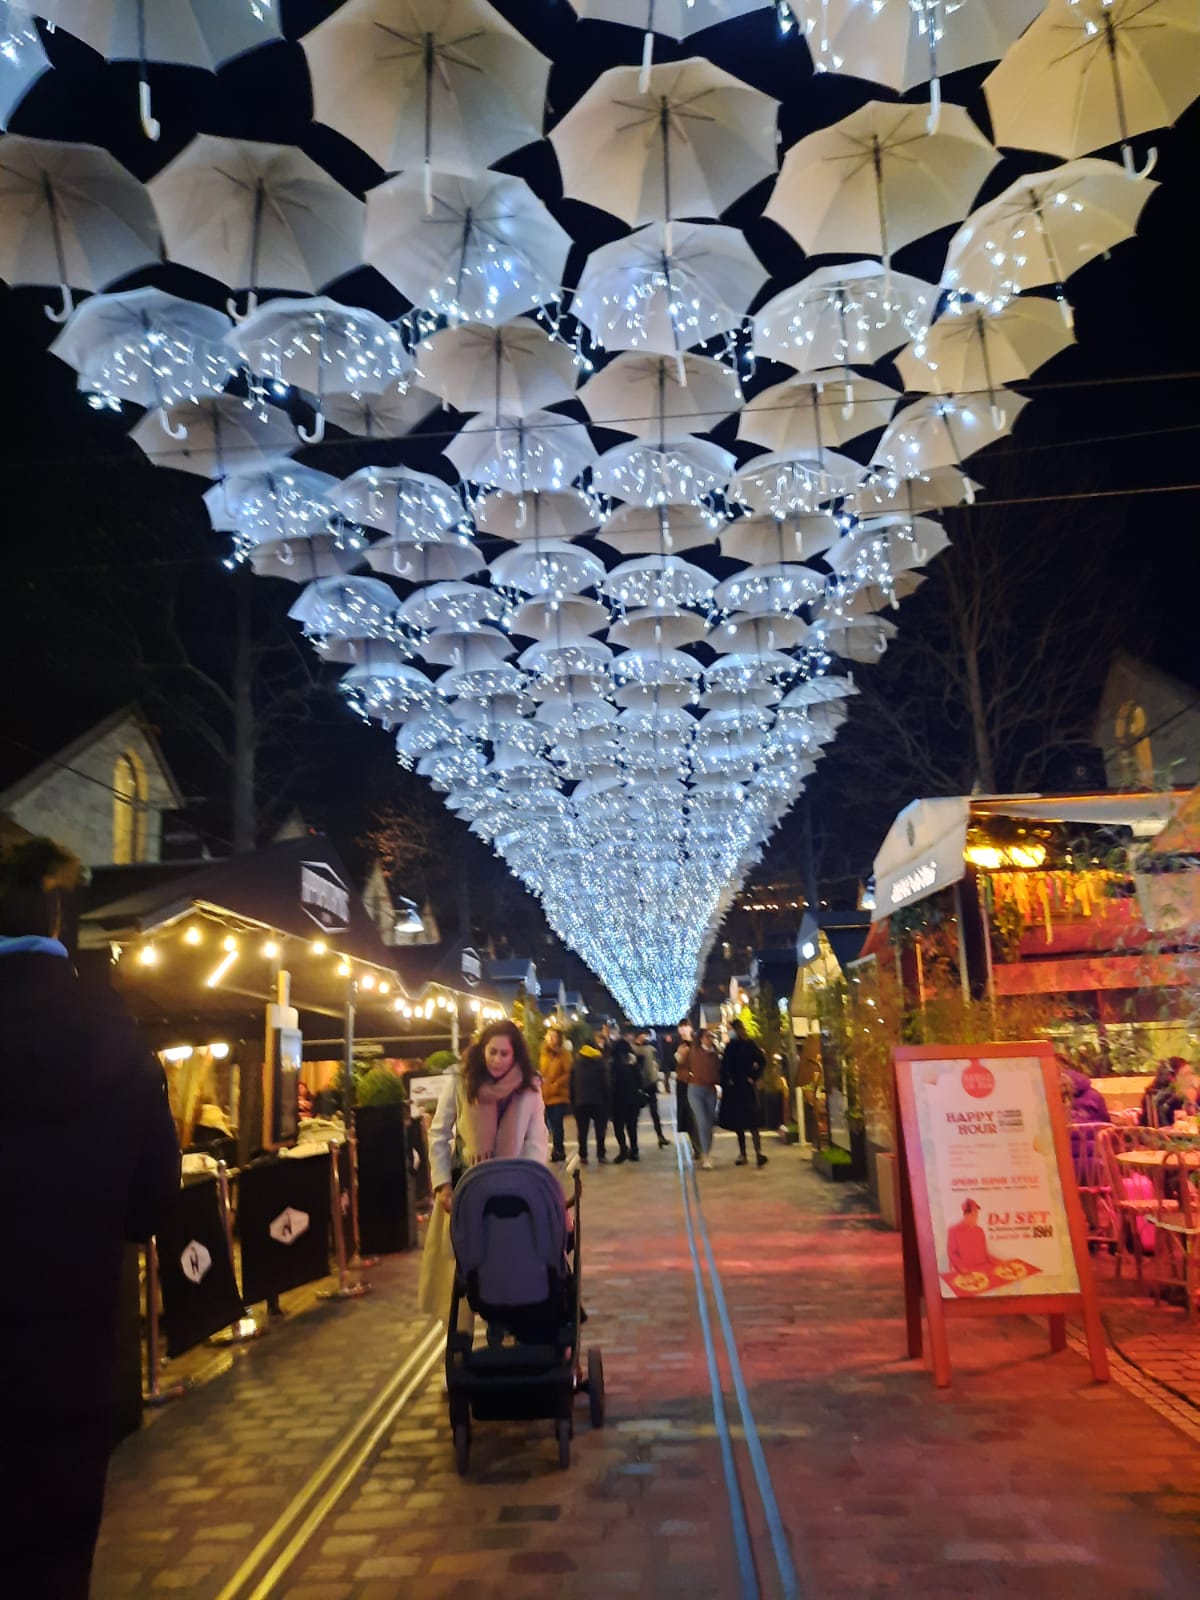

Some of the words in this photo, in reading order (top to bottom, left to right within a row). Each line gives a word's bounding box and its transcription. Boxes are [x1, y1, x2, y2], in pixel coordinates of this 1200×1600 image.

[946, 1111, 993, 1122] HAPPY
[959, 1124, 997, 1135] HOUR
[988, 1212, 1010, 1225] DJ
[1015, 1210, 1050, 1223] SET
